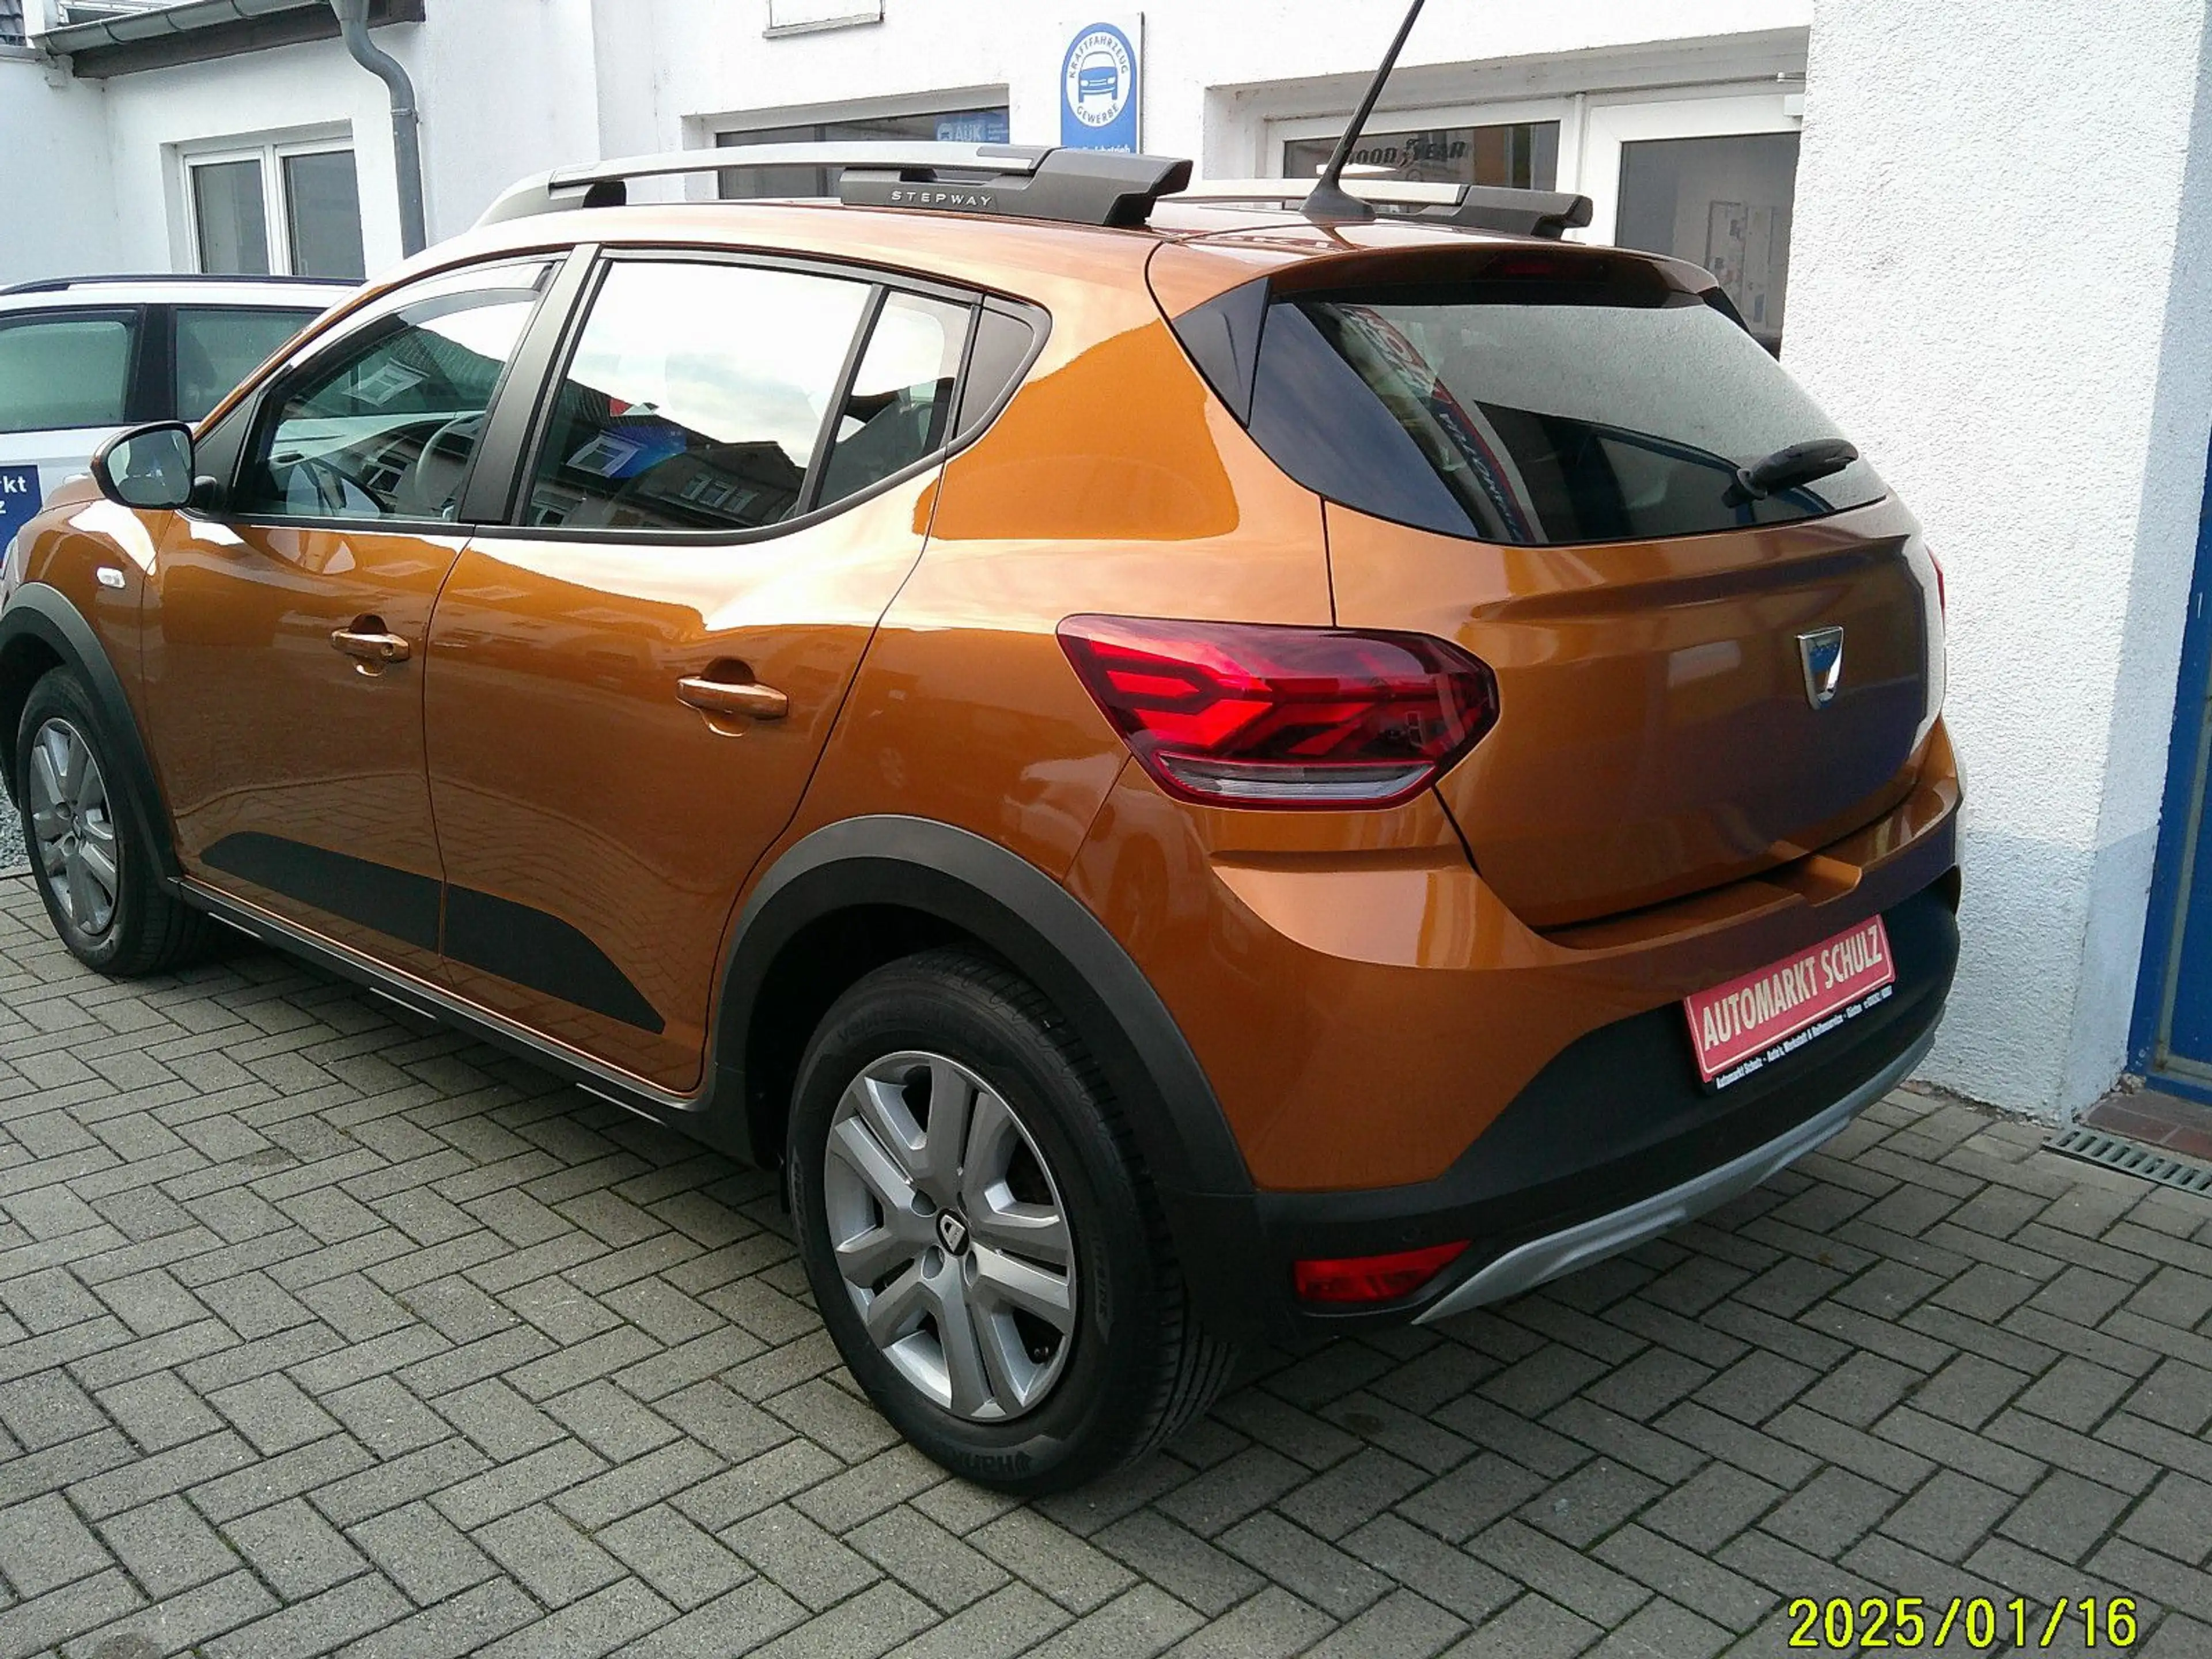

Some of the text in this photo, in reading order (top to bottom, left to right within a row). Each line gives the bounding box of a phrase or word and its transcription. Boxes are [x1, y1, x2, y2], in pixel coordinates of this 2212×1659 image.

[1069, 35, 1129, 79] KRAFTFAHRZEUG
[1077, 102, 1119, 124] GEWERBE
[891, 190, 992, 206] STEPWAY
[1703, 956, 1818, 1052] AUTOMARKT
[1820, 925, 1883, 990] SCHULZ
